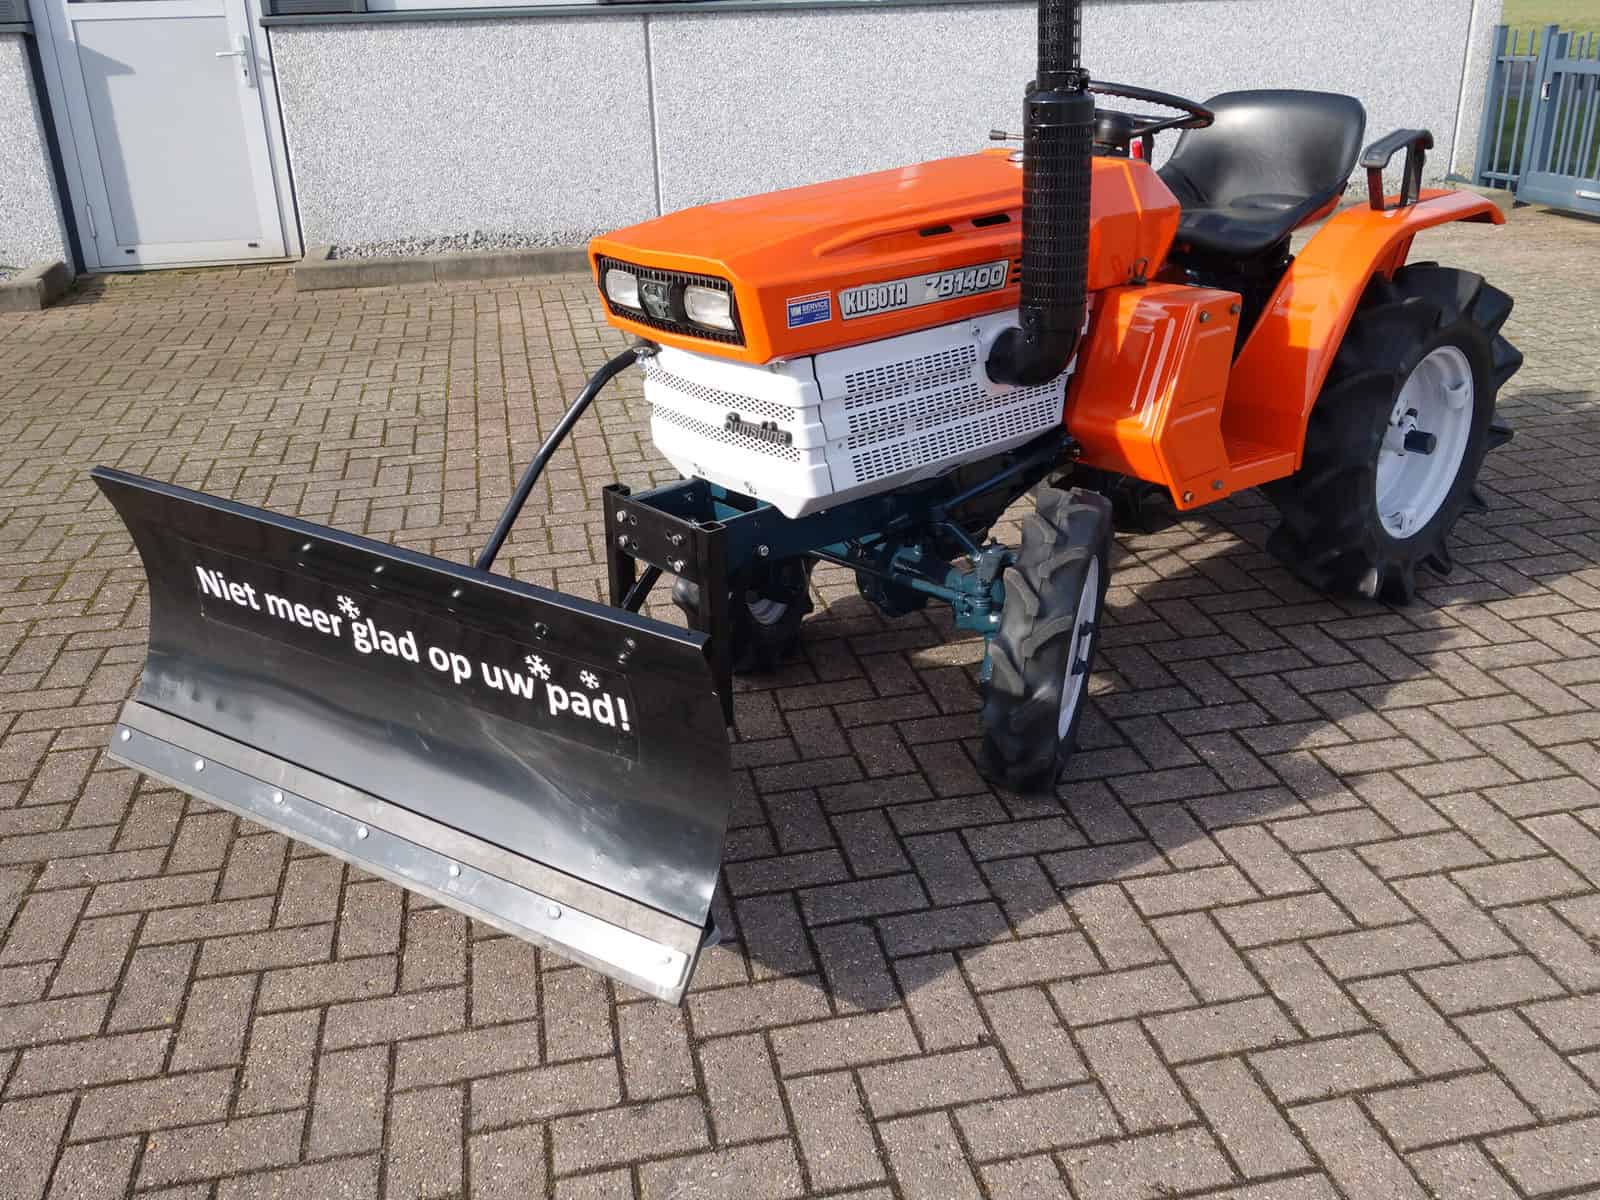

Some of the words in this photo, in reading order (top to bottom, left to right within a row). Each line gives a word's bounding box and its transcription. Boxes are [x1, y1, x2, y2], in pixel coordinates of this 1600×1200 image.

[844, 282, 908, 315] KUBOTA
[924, 264, 1005, 298] ZB1400
[195, 566, 261, 610] Niet
[264, 592, 341, 637] meer
[352, 619, 419, 663] glad
[429, 645, 472, 684] op
[482, 662, 534, 699] uw
[546, 681, 630, 731] pad!
